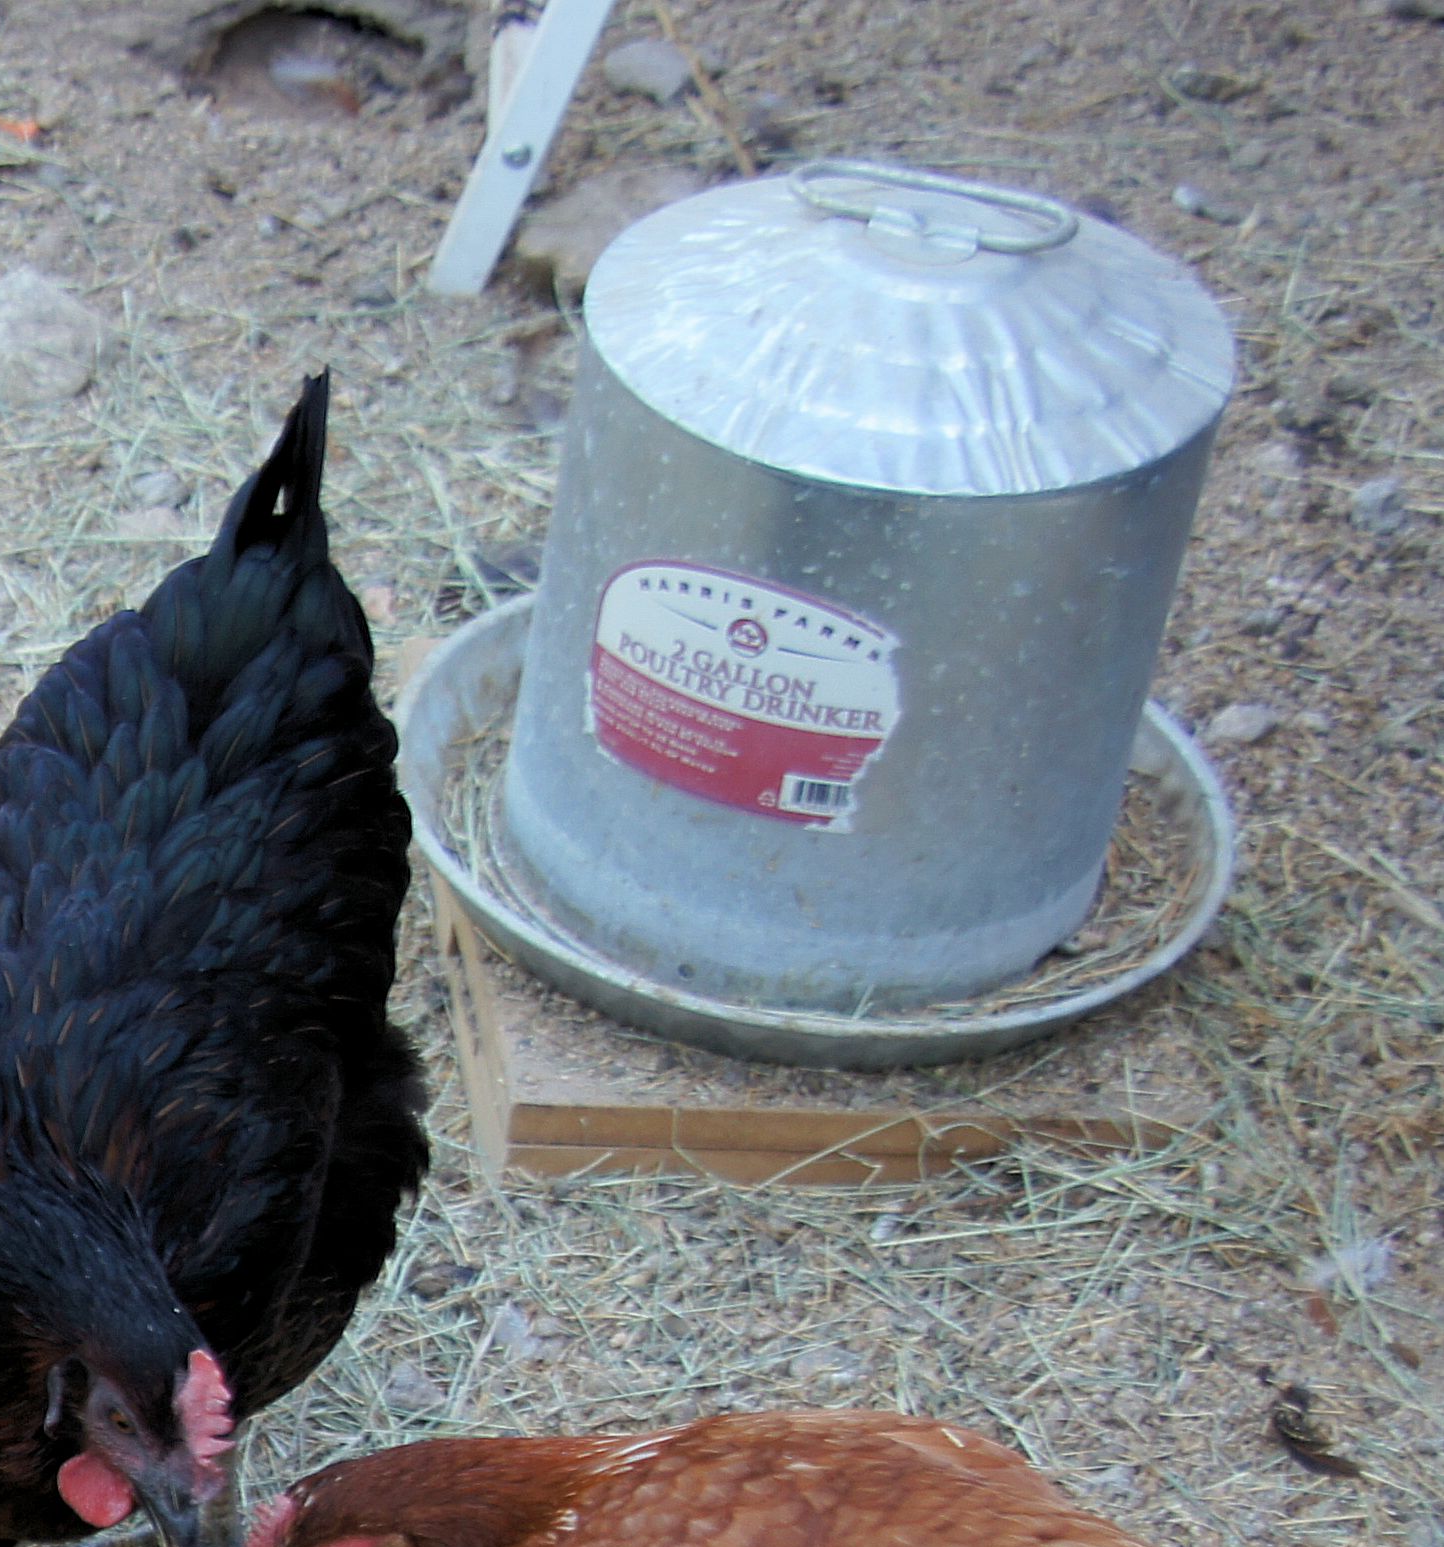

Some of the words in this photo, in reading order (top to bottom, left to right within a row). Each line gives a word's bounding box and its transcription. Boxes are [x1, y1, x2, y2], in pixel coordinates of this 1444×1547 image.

[638, 577, 754, 611] HARRIS
[773, 607, 881, 662] FARMS
[618, 632, 735, 703] POULTRY
[741, 686, 885, 732] DRINKER
[671, 639, 687, 661] 2
[691, 649, 817, 700] GALLON
